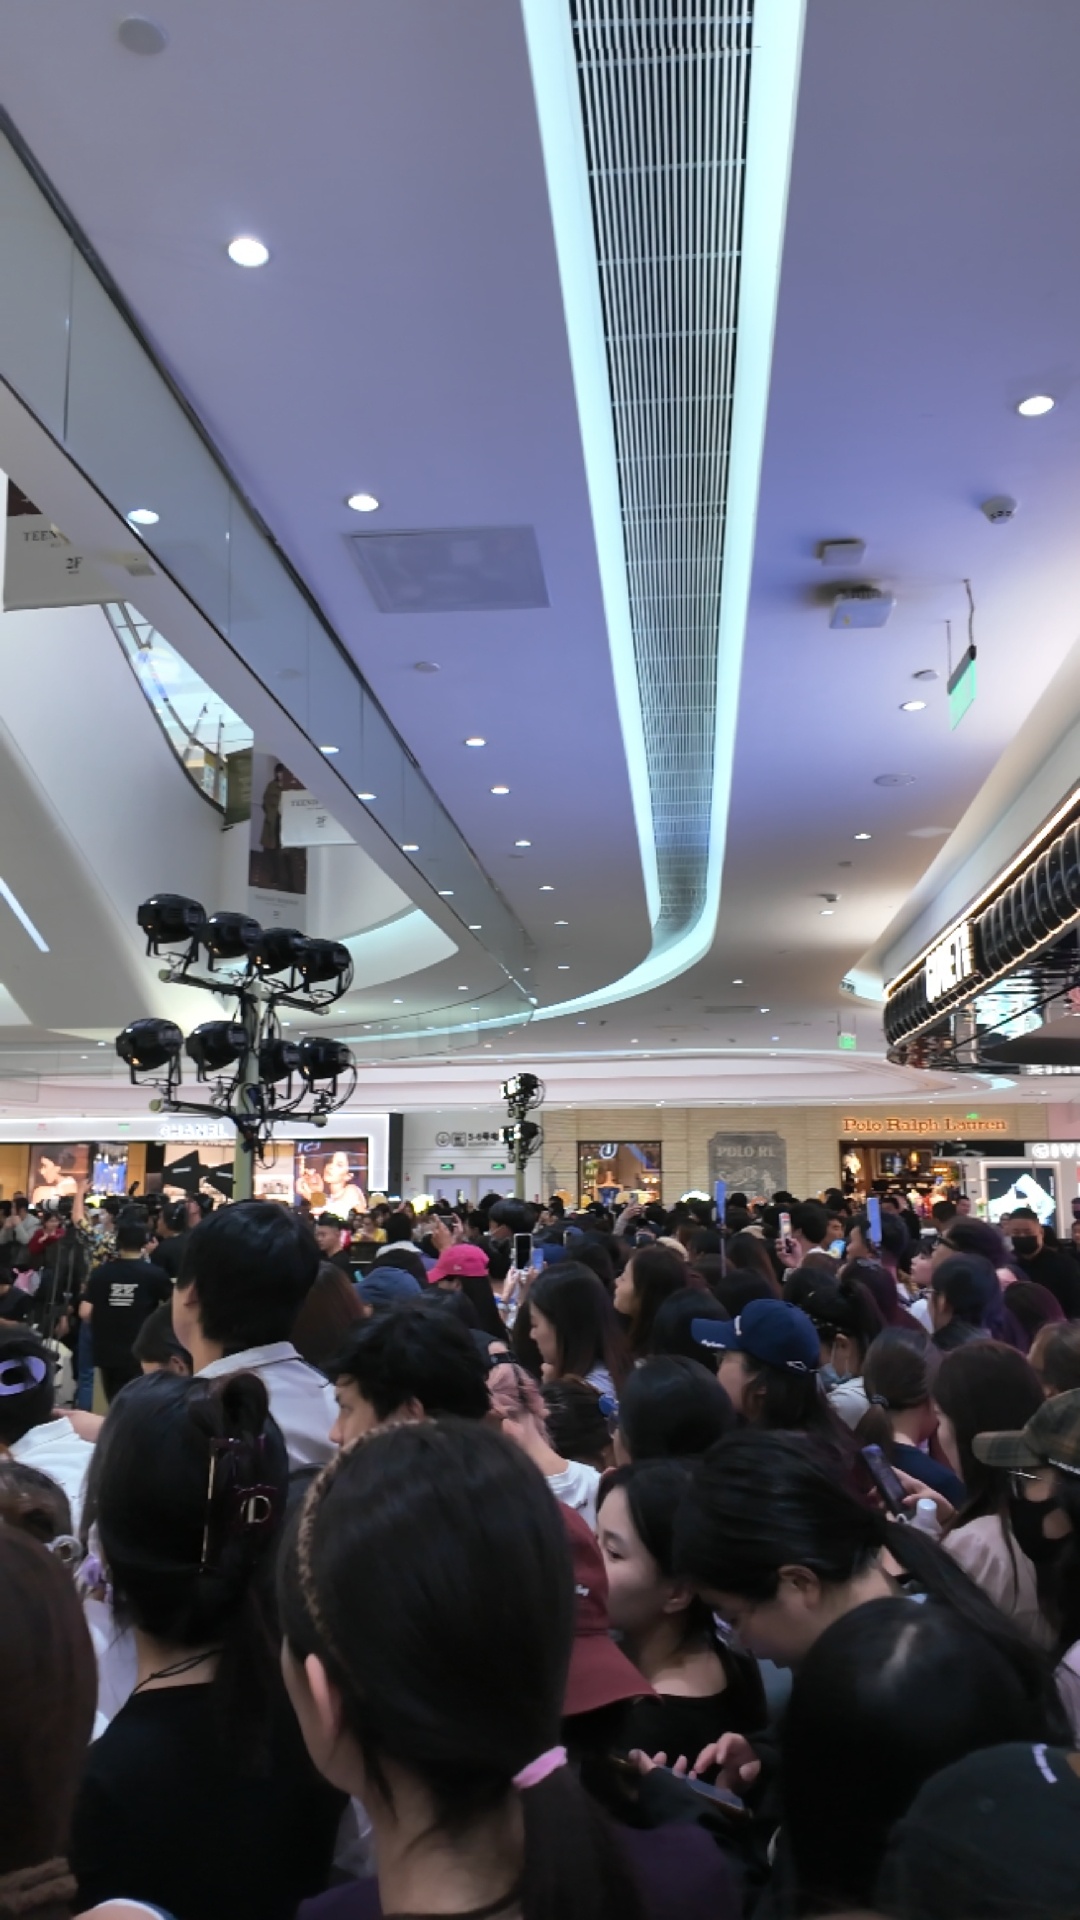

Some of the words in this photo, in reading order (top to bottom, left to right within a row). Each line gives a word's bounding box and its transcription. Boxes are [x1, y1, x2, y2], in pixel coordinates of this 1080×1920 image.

[160, 1123, 229, 1138] CHANEL
[843, 1118, 882, 1133] Polo
[886, 1117, 938, 1134] Ralph
[945, 1117, 1007, 1132] Lauren
[716, 1145, 754, 1157] POLO
[1032, 1143, 1080, 1159] GIV
